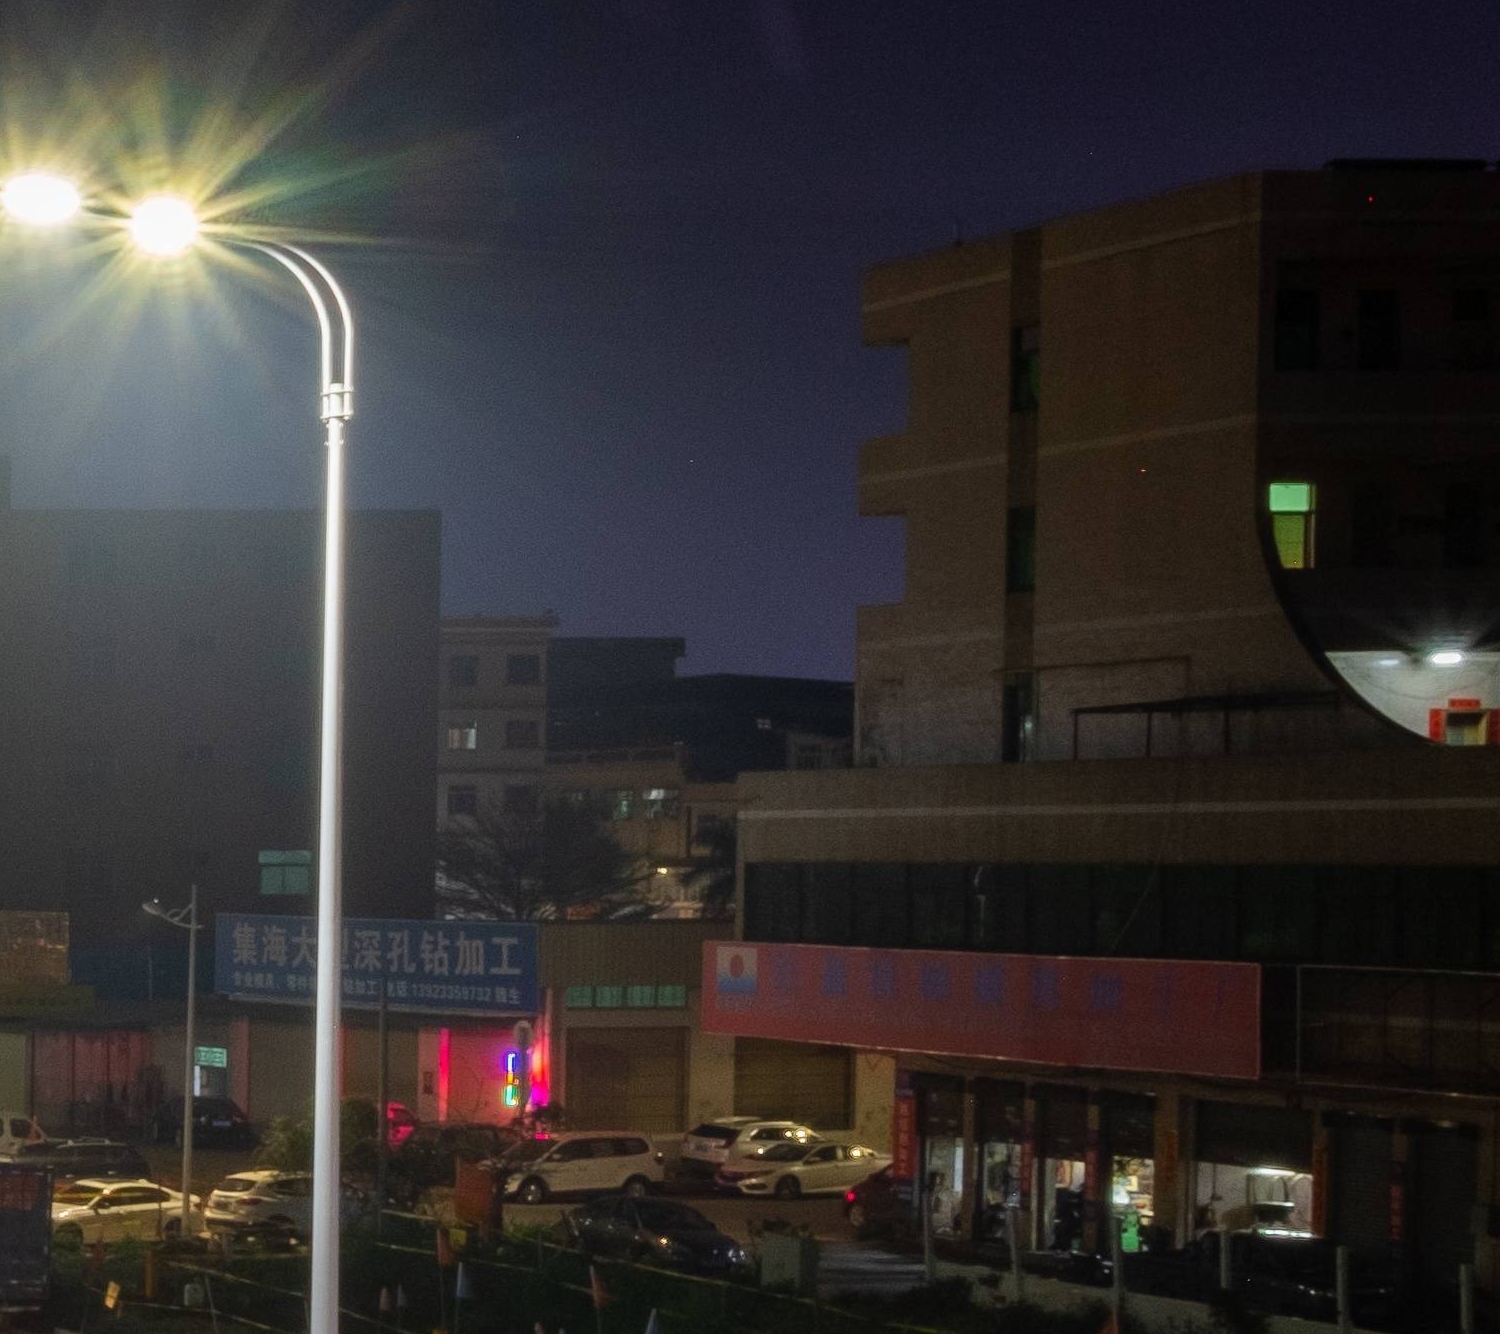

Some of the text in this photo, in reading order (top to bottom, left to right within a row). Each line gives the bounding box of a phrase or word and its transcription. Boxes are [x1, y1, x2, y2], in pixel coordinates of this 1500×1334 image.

[233, 924, 522, 976] 集海大深孔钻加工
